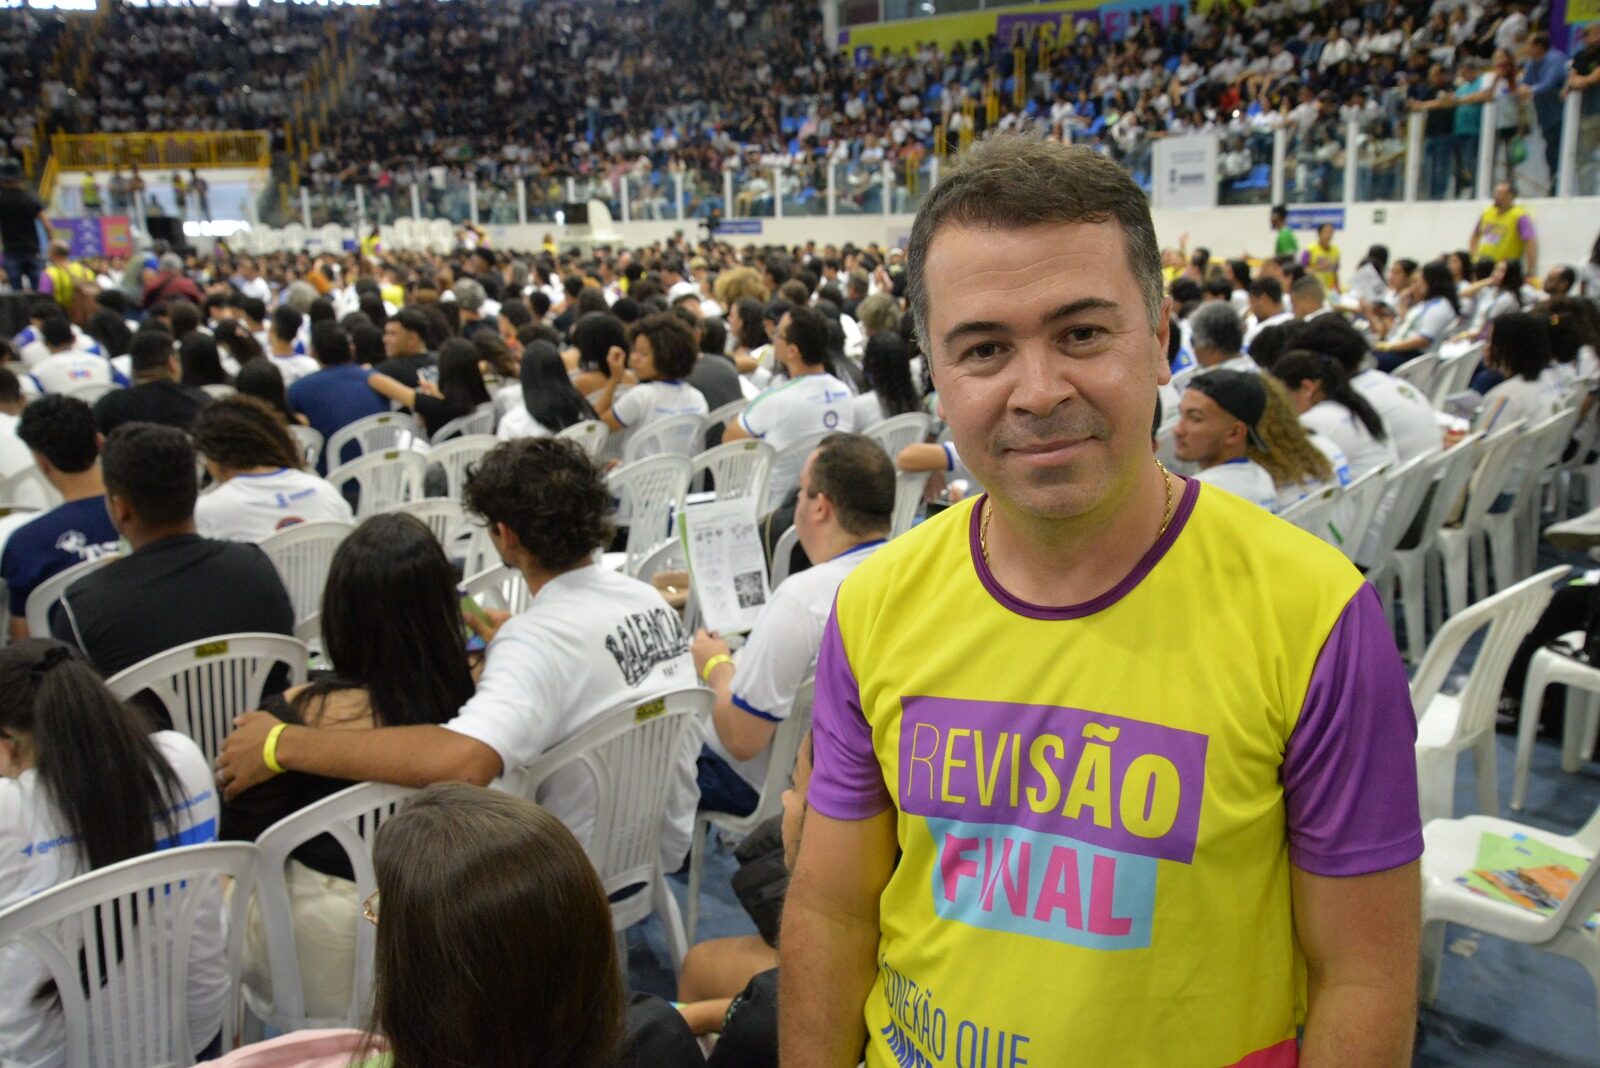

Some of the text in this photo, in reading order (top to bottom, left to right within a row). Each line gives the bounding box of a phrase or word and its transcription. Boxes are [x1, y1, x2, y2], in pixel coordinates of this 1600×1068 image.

[907, 722, 1181, 839] REVISÃO
[941, 832, 1133, 936] FINAL
[955, 1020, 1030, 1068] QUE
